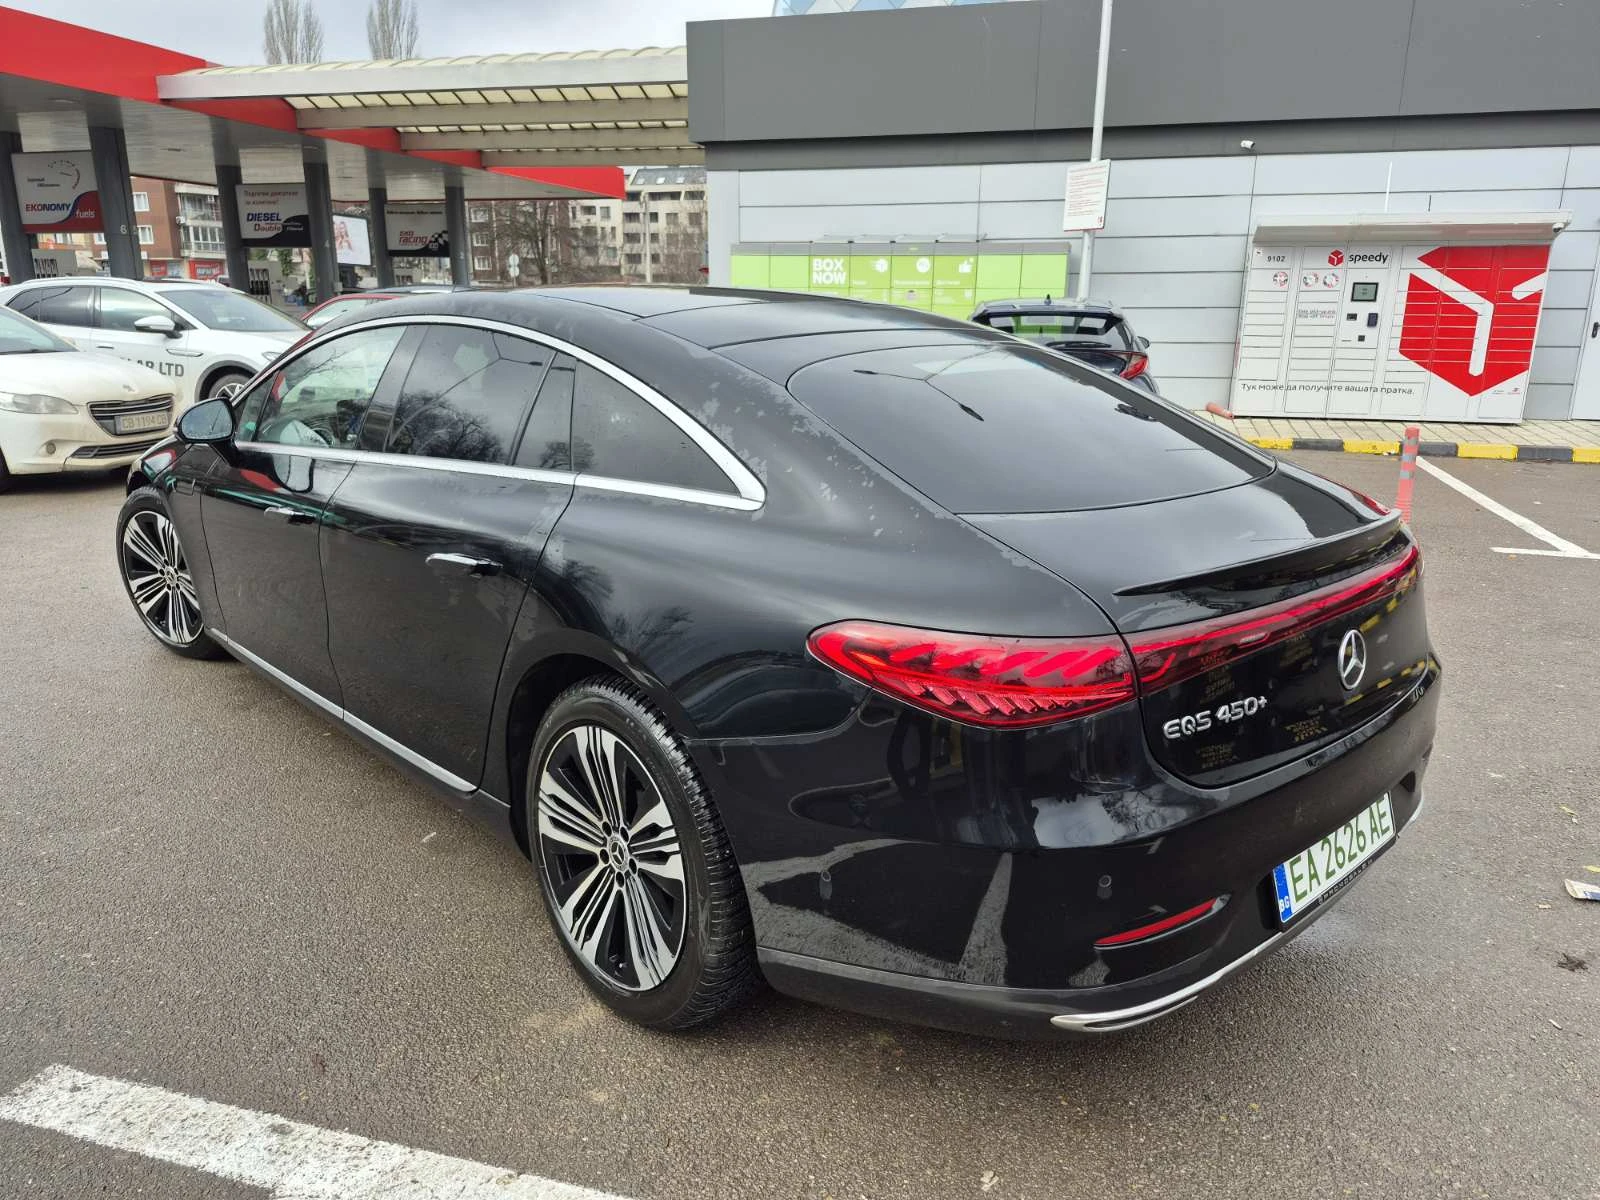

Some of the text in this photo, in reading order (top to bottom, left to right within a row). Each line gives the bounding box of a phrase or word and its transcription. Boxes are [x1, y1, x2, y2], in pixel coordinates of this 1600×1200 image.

[25, 203, 71, 212] EKONOMY
[75, 208, 97, 218] fuels
[246, 212, 282, 222] DIESEL
[812, 258, 844, 271] BOX
[1348, 252, 1389, 264] speedy
[812, 272, 846, 285] NOW
[159, 361, 185, 377] LTD
[1241, 383, 1257, 391] Тук
[1299, 384, 1343, 393] получите
[1344, 385, 1378, 393] вашата
[1163, 695, 1268, 739] EQS 450+
[1289, 848, 1321, 903] EA
[1321, 814, 1366, 881] 2626
[1369, 799, 1390, 845] AE
[1279, 896, 1290, 913] BG
